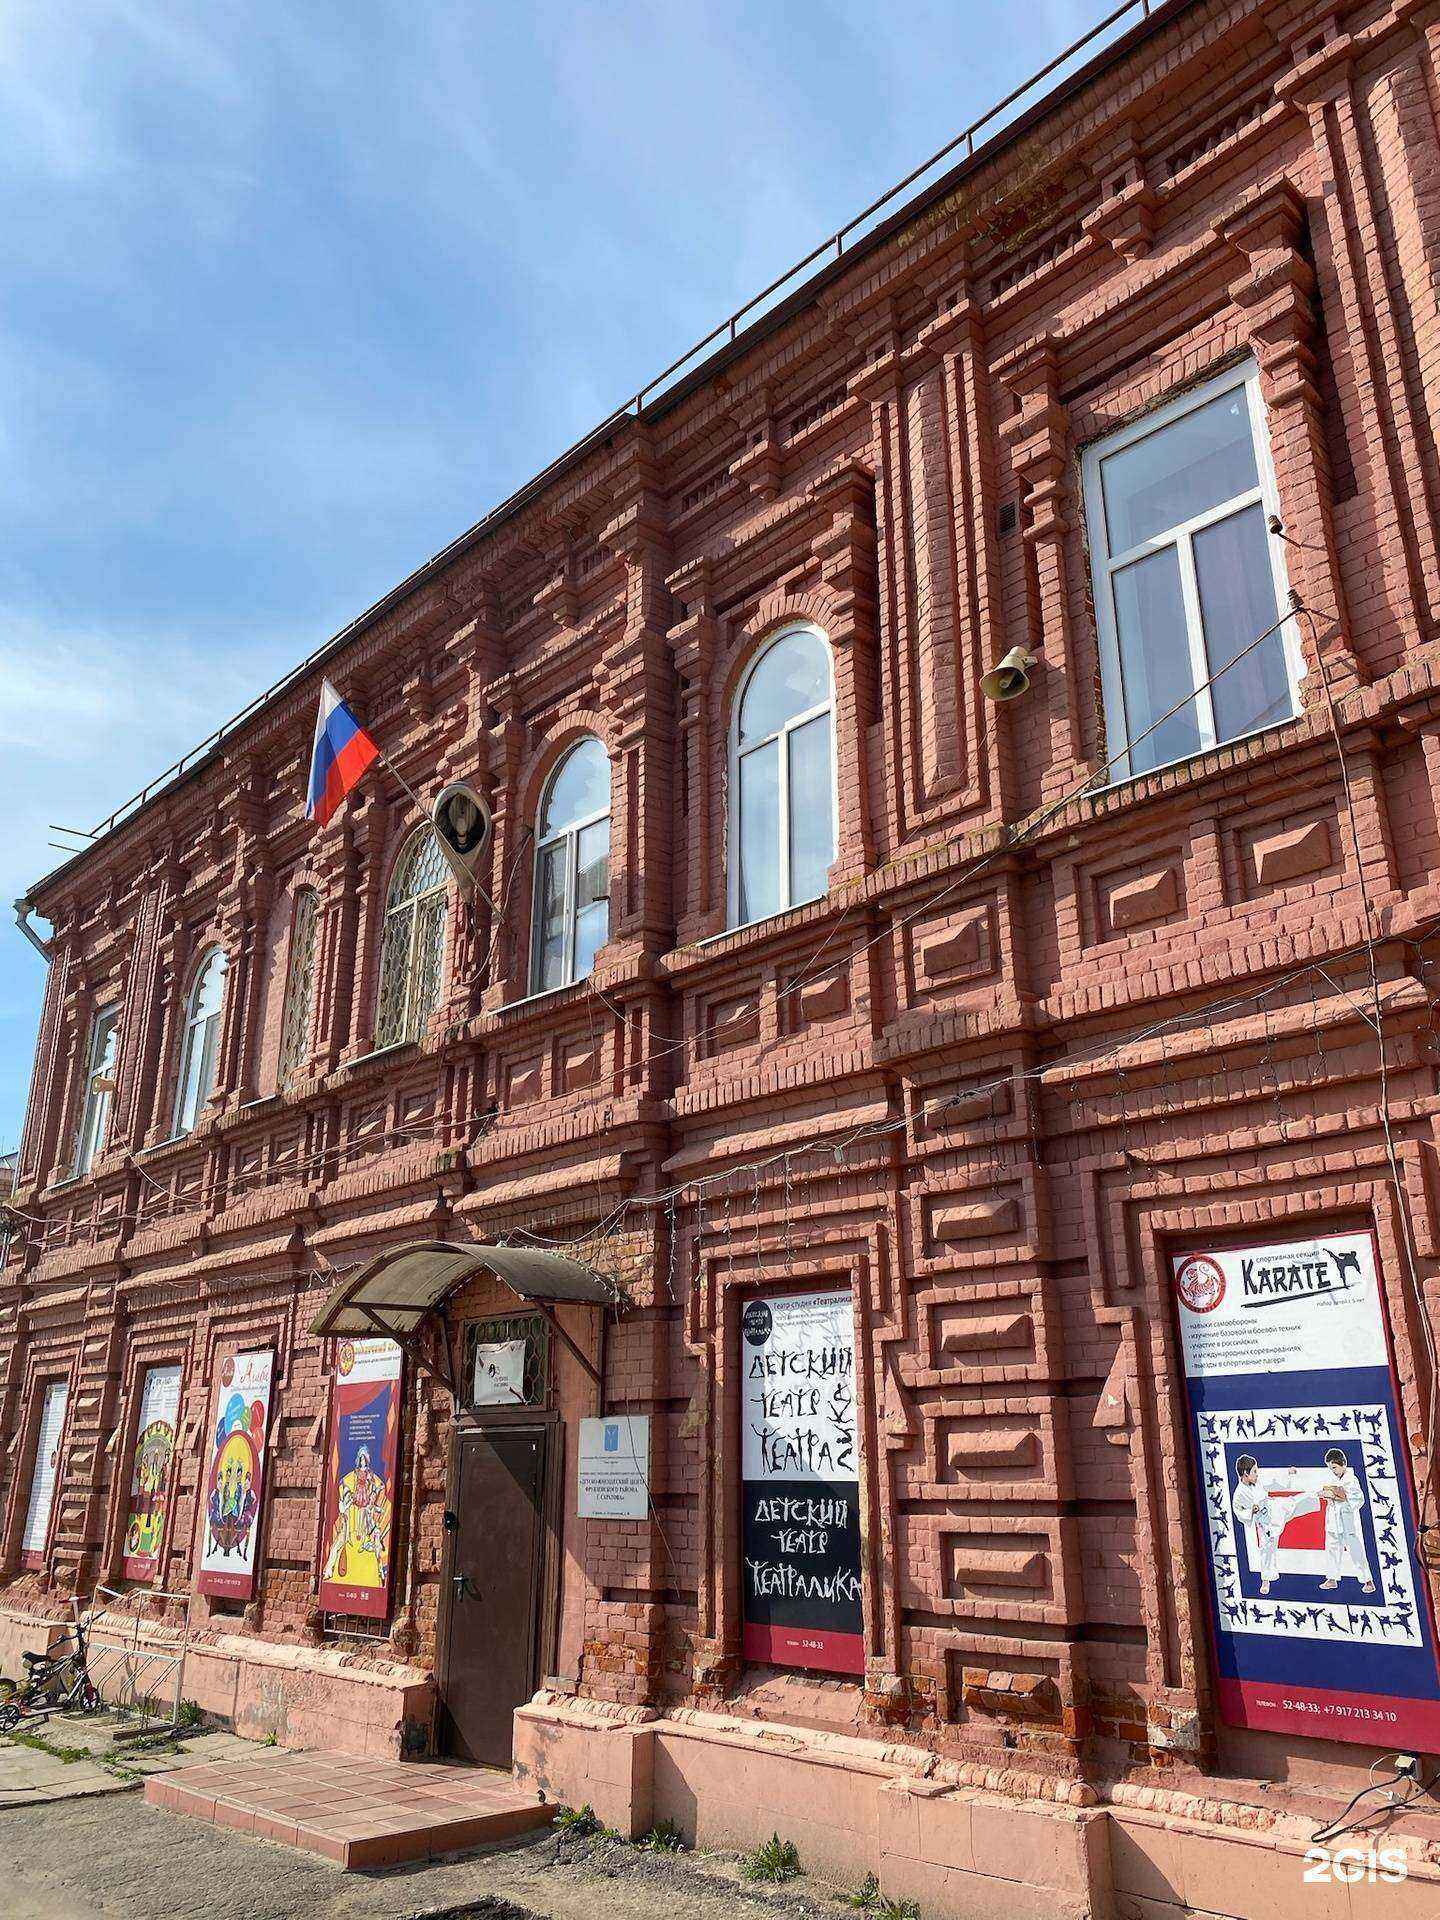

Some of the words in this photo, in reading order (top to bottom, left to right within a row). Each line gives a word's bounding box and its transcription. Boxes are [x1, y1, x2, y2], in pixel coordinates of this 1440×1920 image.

[1256, 1253, 1296, 1264] спортивная
[1241, 1258, 1332, 1296] KARATE
[1335, 1706, 1352, 1717] 917
[1354, 1708, 1371, 1719] 213
[1372, 1709, 1385, 1720] 34
[1386, 1711, 1398, 1722] 10
